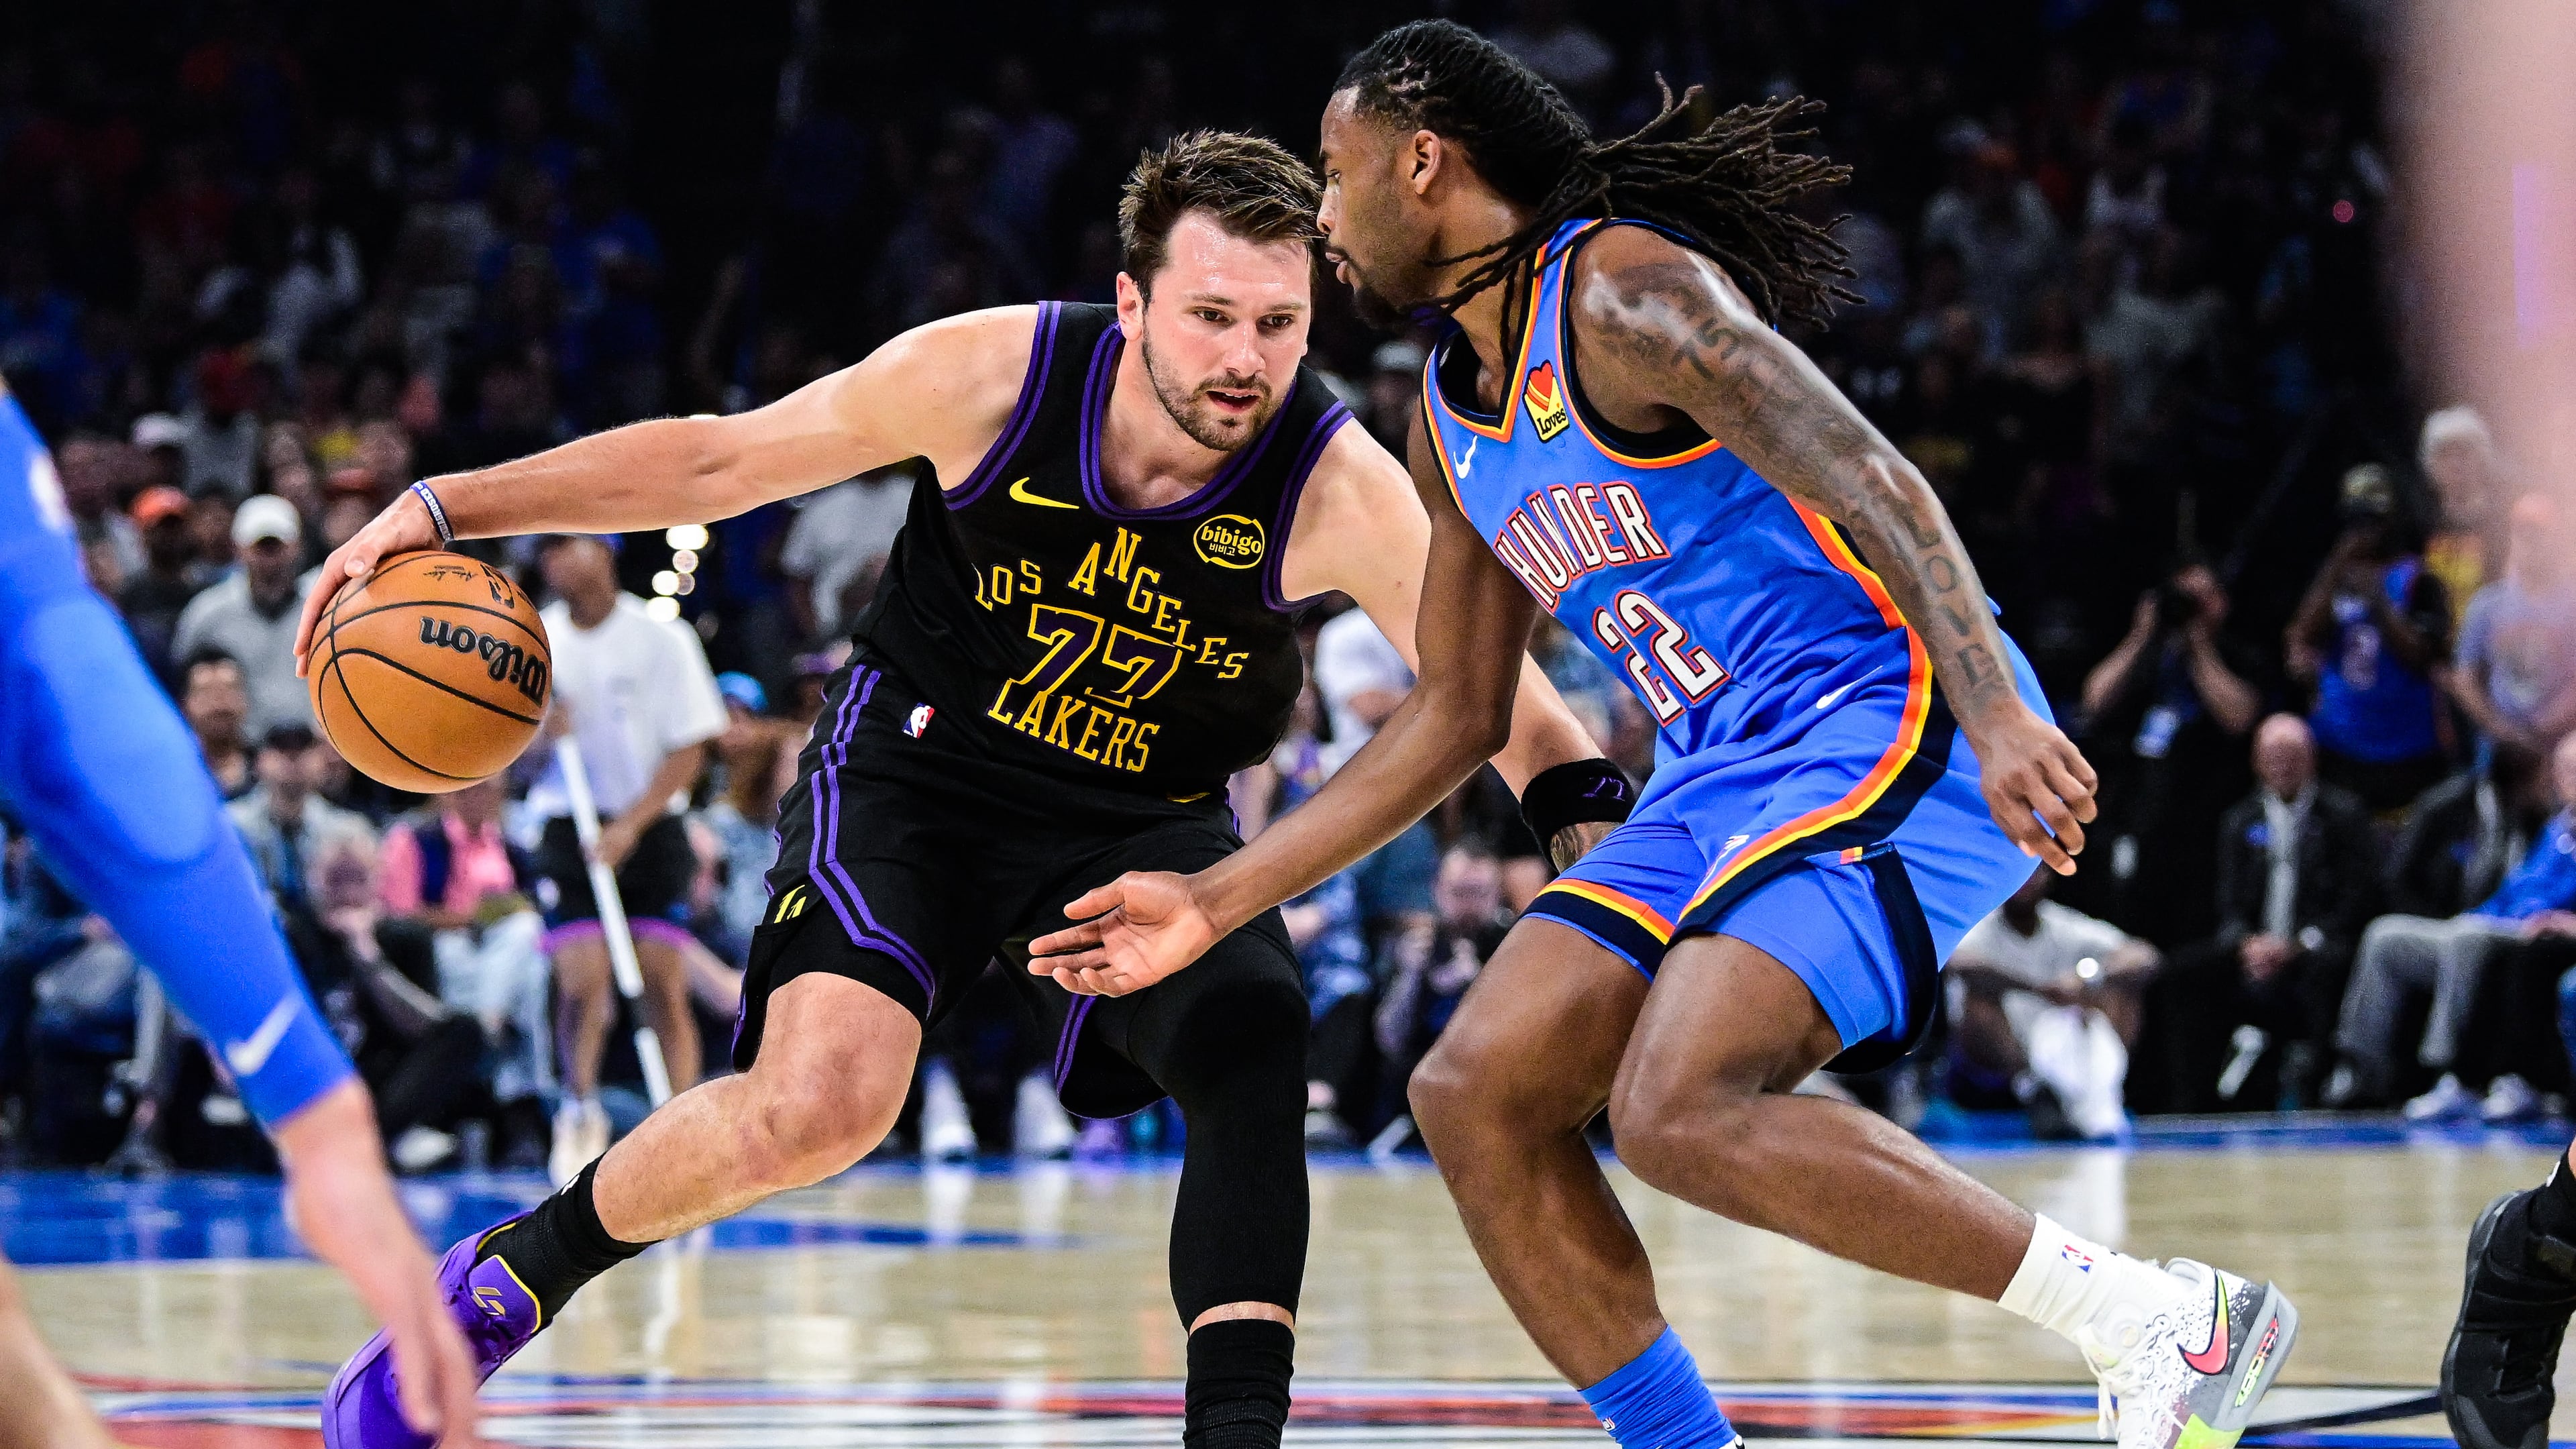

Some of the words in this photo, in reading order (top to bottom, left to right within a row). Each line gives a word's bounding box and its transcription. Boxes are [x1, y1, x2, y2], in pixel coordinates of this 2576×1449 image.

[1201, 525, 1262, 556] bibigo
[1209, 542, 1236, 556] 비비고
[1493, 481, 1672, 613] HUNDER
[971, 560, 1042, 611] LOS
[1067, 527, 1250, 679] ANGELES
[419, 616, 547, 708] Wilson
[1010, 603, 1183, 708] 77
[1592, 589, 1732, 727] 22
[987, 678, 1161, 772] LAKERS
